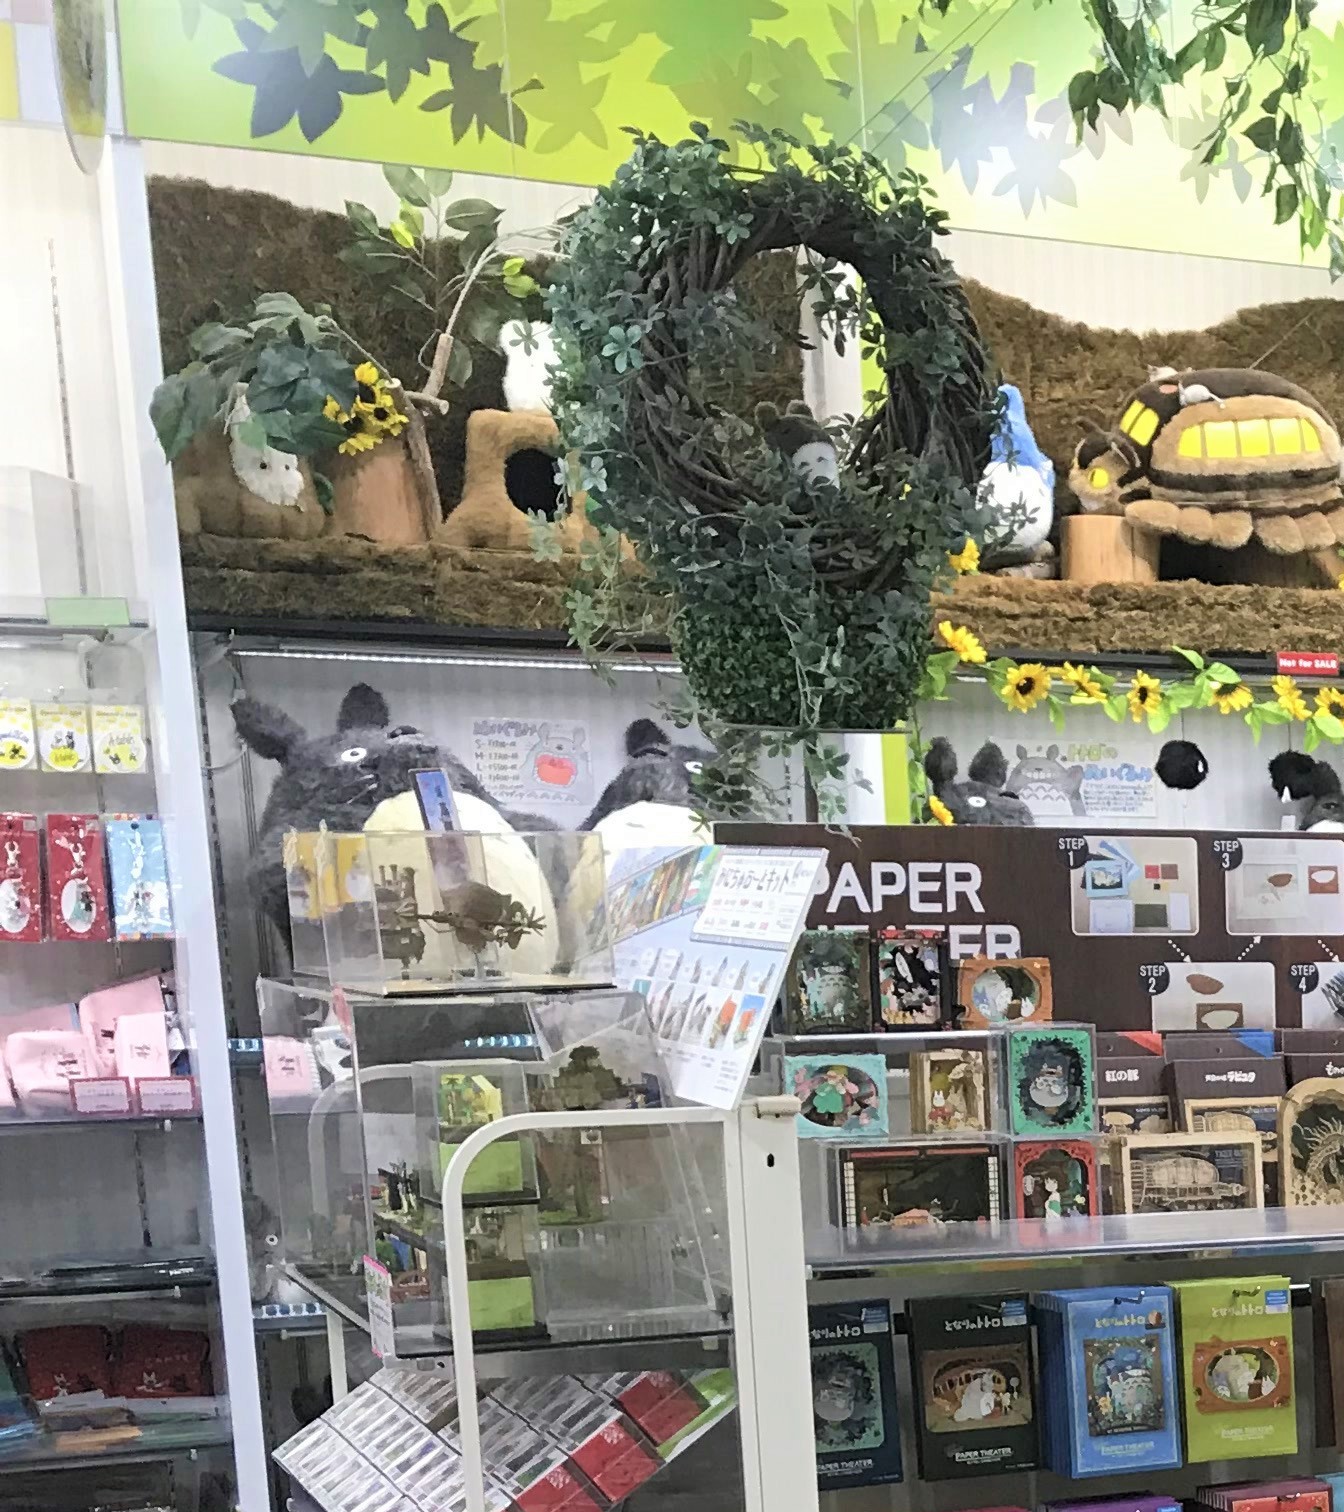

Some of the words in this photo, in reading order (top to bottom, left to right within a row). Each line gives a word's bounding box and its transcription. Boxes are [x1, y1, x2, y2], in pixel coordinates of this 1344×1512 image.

[1279, 658, 1297, 667] Not
[1298, 658, 1313, 668] for
[1314, 659, 1337, 668] SALE
[1059, 838, 1085, 851] STEP
[1213, 839, 1240, 852] STEP
[1068, 852, 1076, 866] 1
[1221, 854, 1231, 869] 3
[1140, 965, 1166, 978] STEP
[1291, 964, 1316, 977] STEP
[1148, 978, 1157, 993] 2
[1298, 977, 1308, 992] 4
[955, 1451, 979, 1461] PAPER
[980, 1447, 1012, 1458] THEATER
